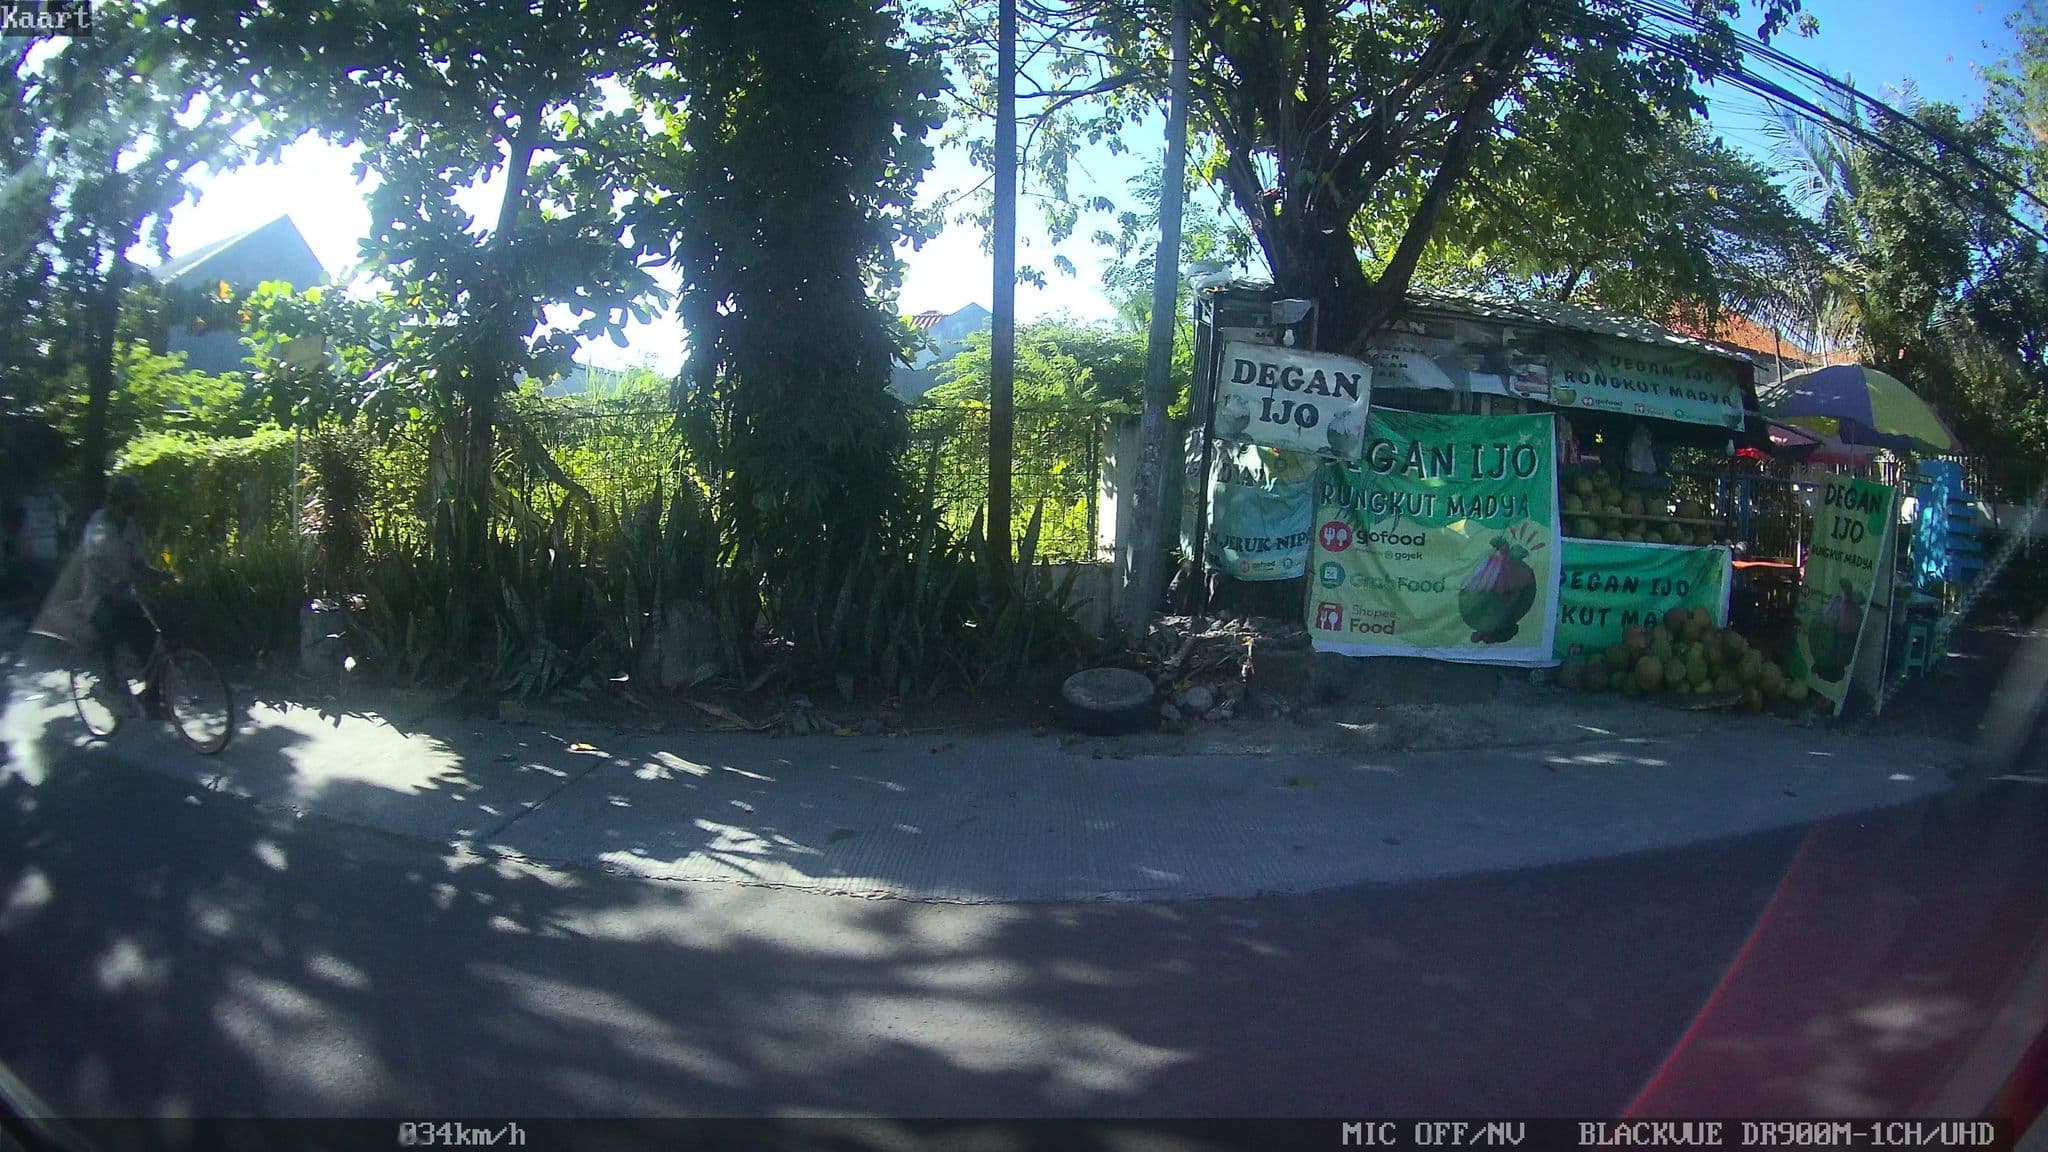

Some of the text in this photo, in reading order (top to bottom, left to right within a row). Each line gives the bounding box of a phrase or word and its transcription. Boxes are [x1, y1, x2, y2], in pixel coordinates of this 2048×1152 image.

[1231, 359, 1362, 402] DEGAN
[1259, 397, 1319, 428] IJO
[1471, 443, 1538, 480] IJO
[1321, 482, 1531, 520] RUNGKUT MADYA
[1825, 483, 1884, 514] DEGAN
[1356, 530, 1426, 547] gofood
[1831, 516, 1865, 544] IJO
[1395, 551, 1423, 561] gojek
[1650, 577, 1689, 597] IJO
[1351, 604, 1397, 619] Shopee
[1350, 619, 1396, 635] Food
